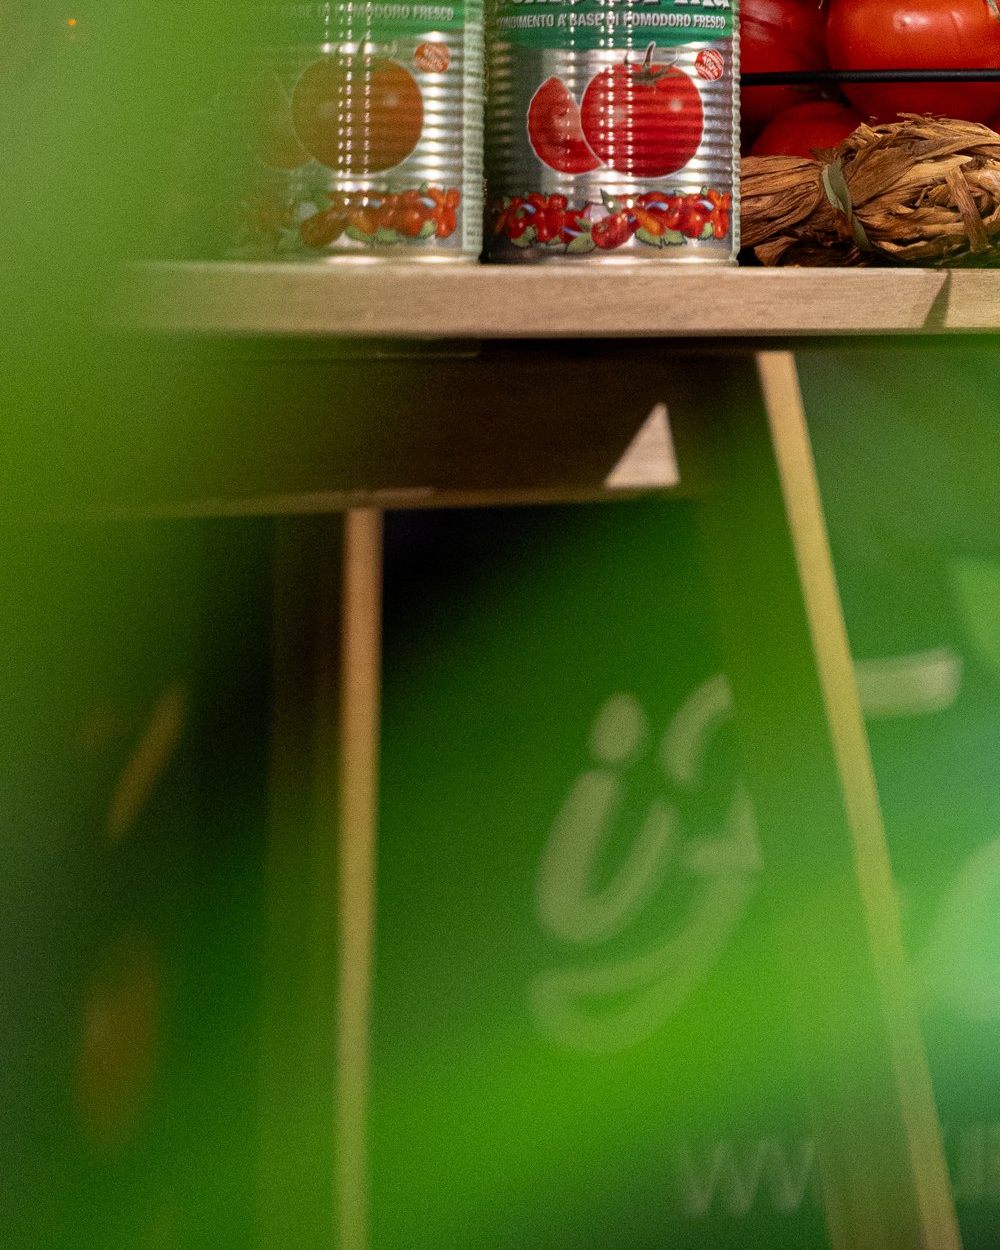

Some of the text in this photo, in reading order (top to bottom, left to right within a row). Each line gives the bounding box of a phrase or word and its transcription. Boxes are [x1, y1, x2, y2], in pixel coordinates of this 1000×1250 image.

[413, 5, 454, 21] FRESCO
[569, 12, 603, 26] BASE
[607, 12, 619, 26] DI
[623, 12, 691, 27] POMODORO
[693, 13, 726, 29] FRESCO
